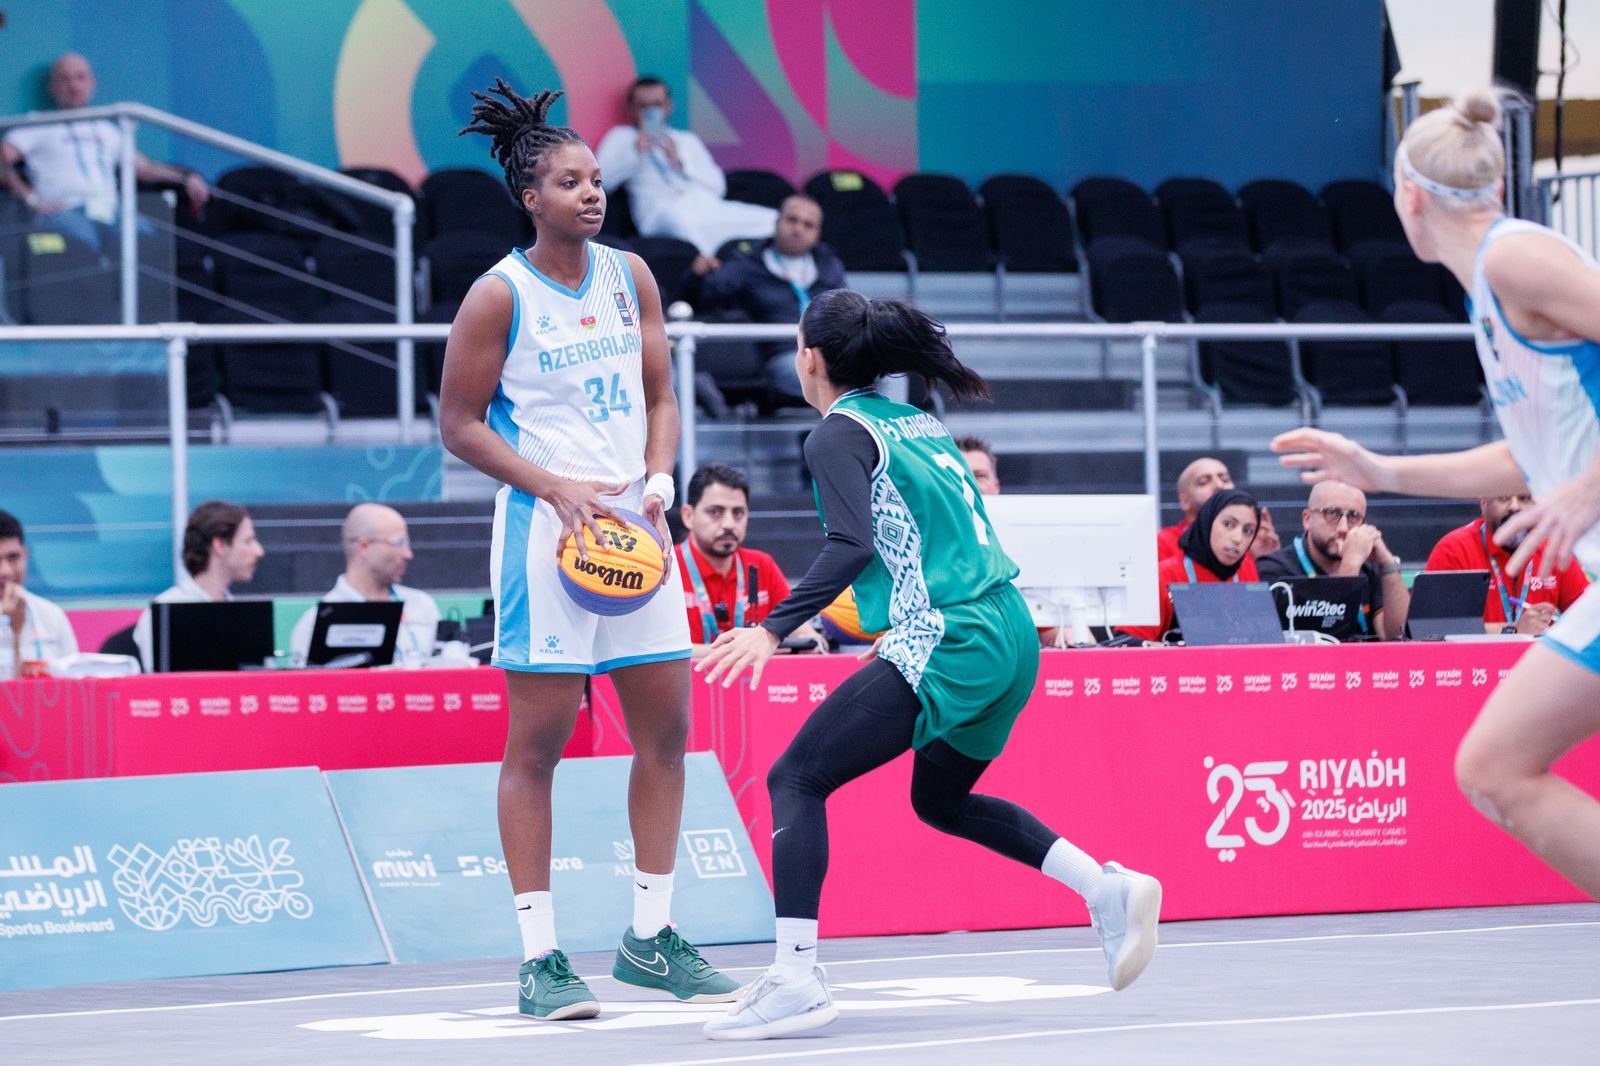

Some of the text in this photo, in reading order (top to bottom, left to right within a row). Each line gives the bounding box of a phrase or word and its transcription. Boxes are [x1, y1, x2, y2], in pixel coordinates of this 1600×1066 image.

[538, 332, 641, 373] AZERBAIJAN
[583, 372, 632, 424] 34
[931, 452, 990, 545] 7
[574, 557, 644, 590] Wilson
[1299, 749, 1406, 796] RIYADH
[1203, 756, 1296, 862] 25
[1301, 796, 1407, 824] الرياض 2025
[0, 845, 97, 878] المس
[694, 837, 729, 853] DA
[372, 853, 437, 879] muvi
[702, 854, 734, 871] ZN
[0, 918, 115, 939] Sports Boulevard
